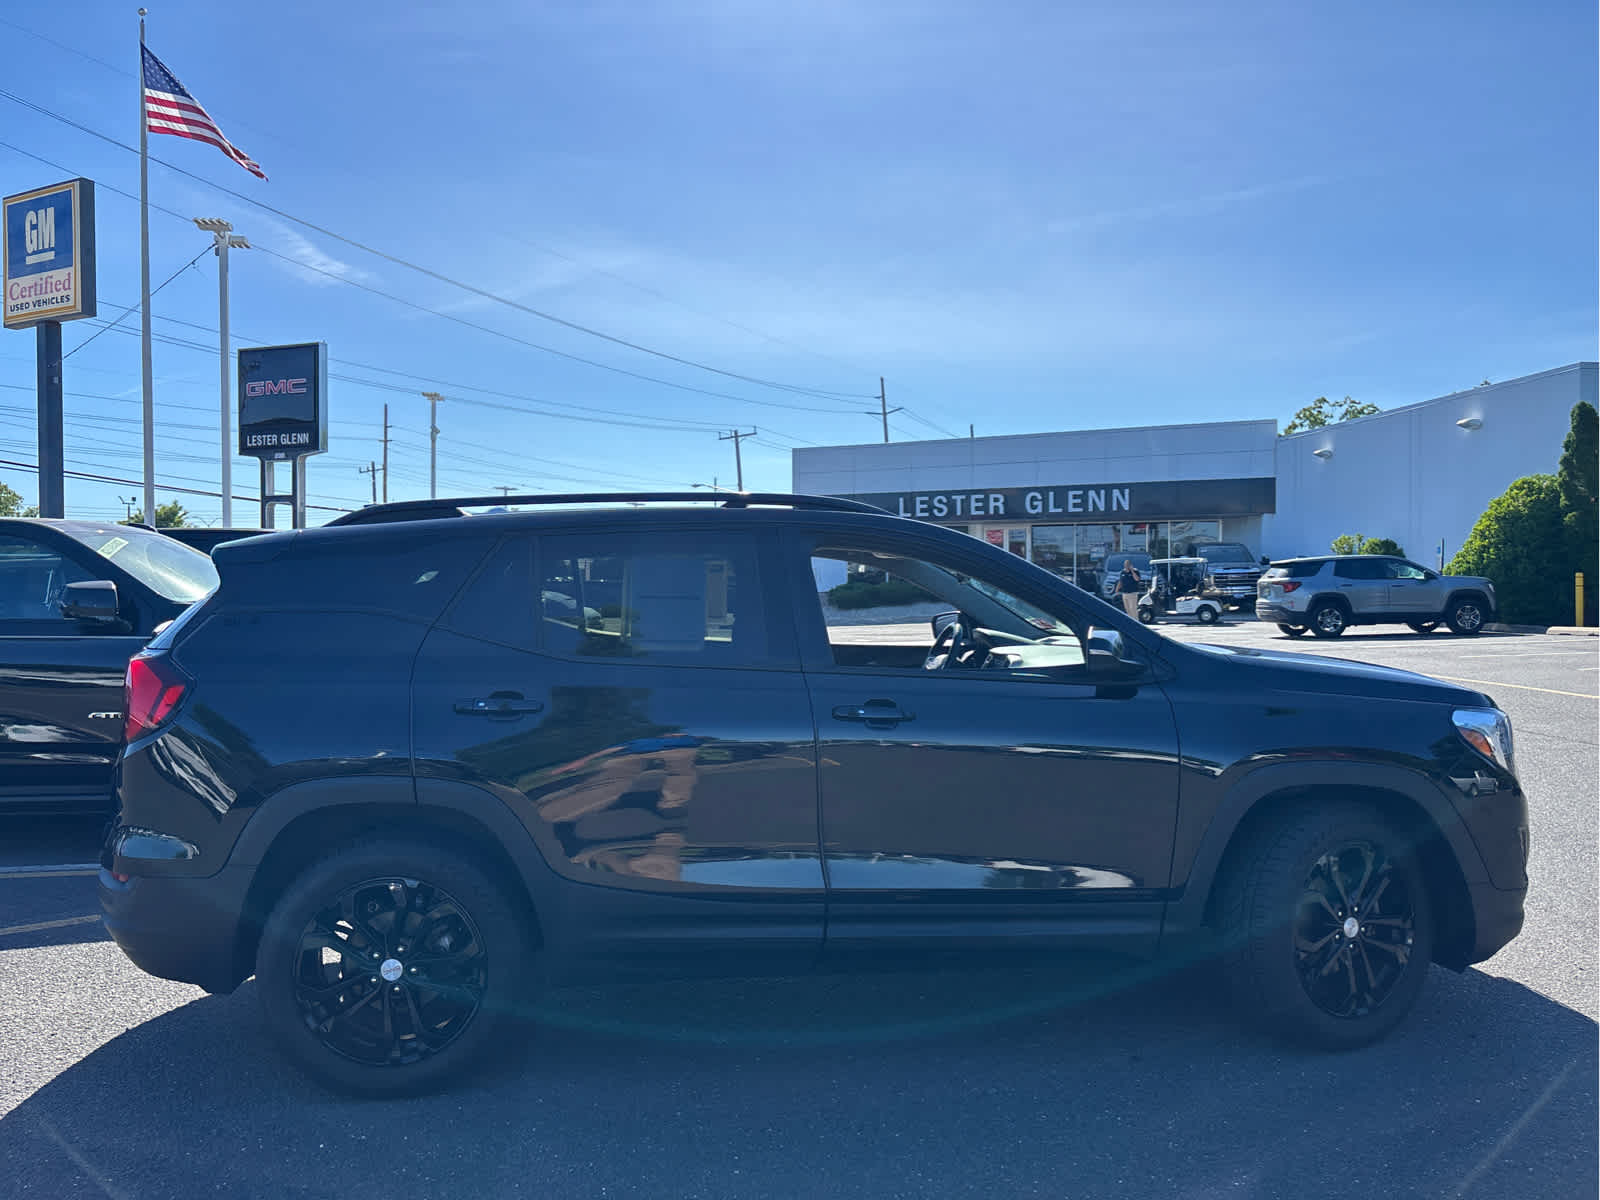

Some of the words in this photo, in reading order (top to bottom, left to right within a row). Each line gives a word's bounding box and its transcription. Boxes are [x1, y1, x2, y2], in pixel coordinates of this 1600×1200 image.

[25, 207, 55, 254] GM
[9, 272, 72, 301] Certified
[10, 301, 30, 312] USED
[32, 294, 71, 309] VEHICLES
[246, 378, 307, 397] GMC
[247, 434, 278, 447] LESTER
[280, 432, 310, 445] GLENN
[899, 493, 1006, 518] LESTER
[1025, 488, 1131, 514] GLENN
